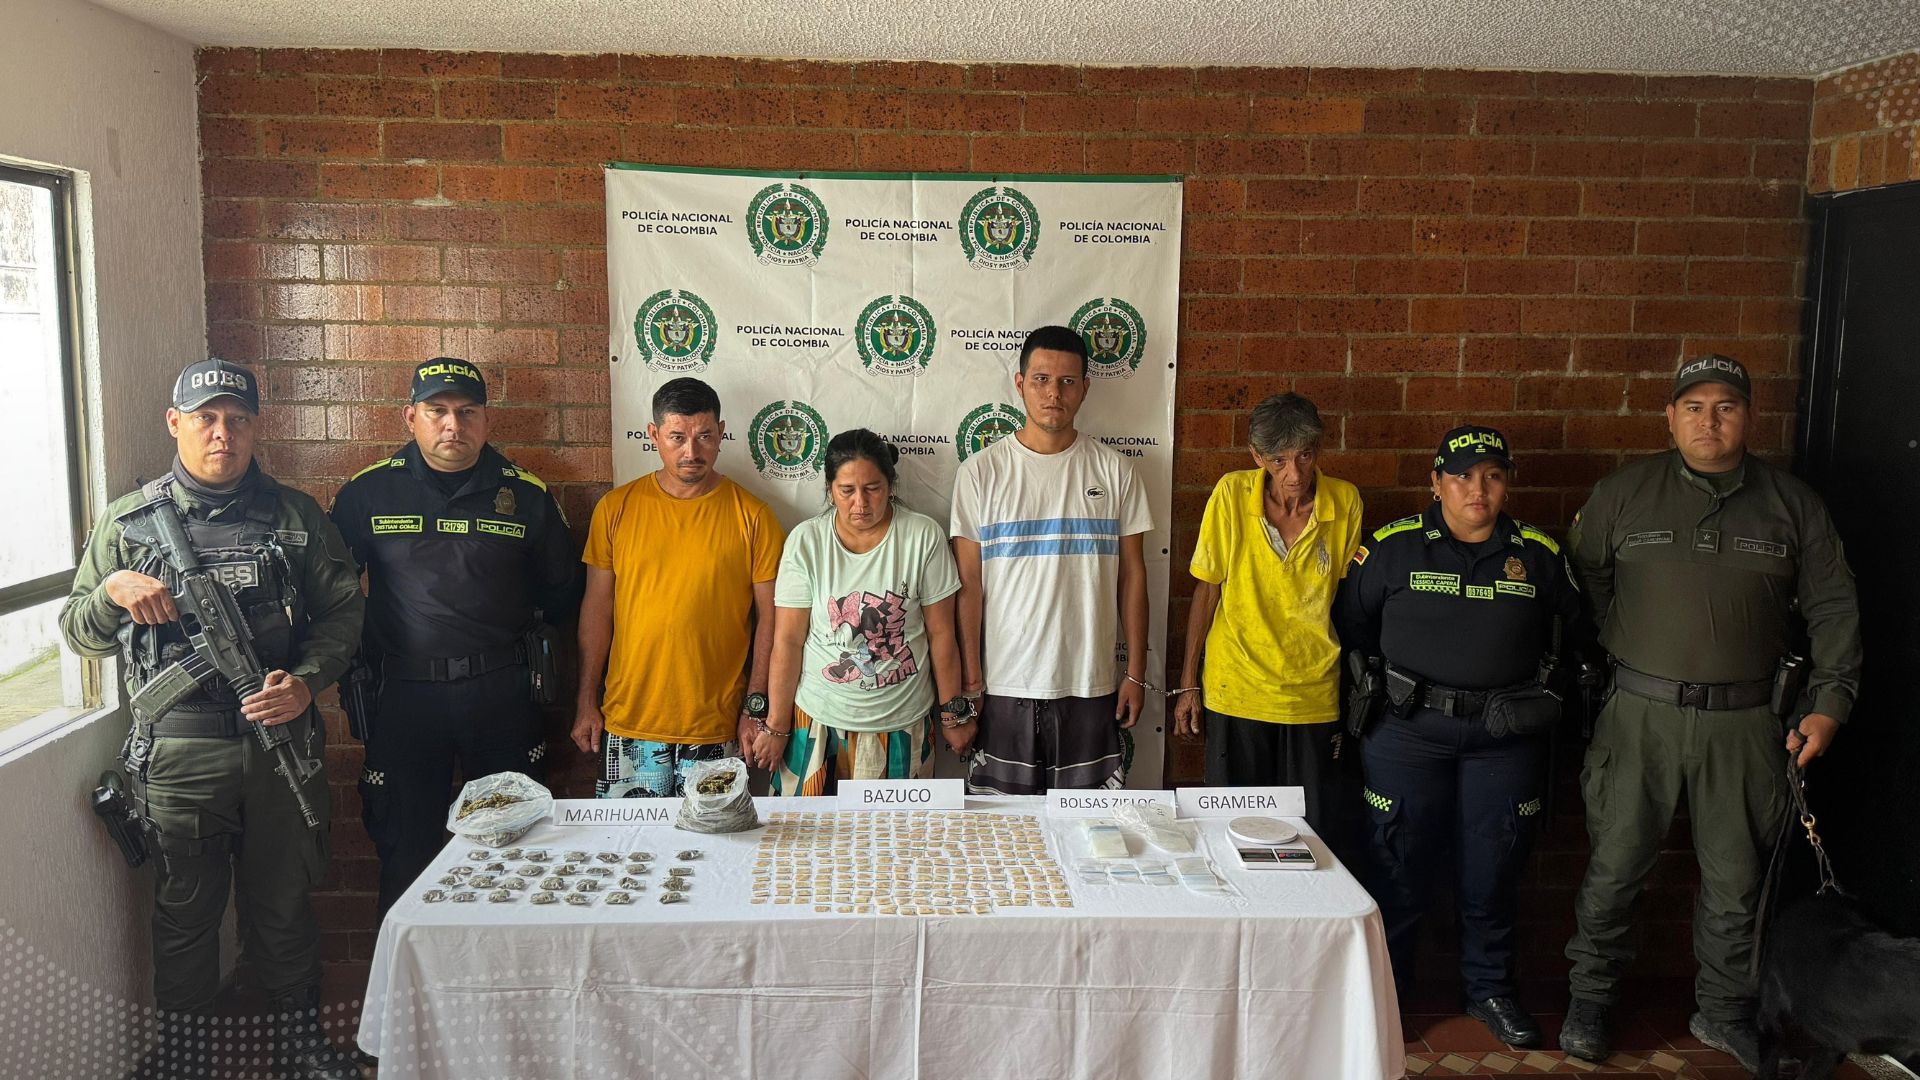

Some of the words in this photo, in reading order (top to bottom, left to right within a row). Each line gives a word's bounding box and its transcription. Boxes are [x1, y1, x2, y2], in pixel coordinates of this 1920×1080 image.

[621, 209, 669, 221] POLICÍA
[671, 212, 733, 224] NACIONAL
[799, 196, 819, 230] COLOMBIA
[1011, 200, 1031, 234] COLOMBIA
[637, 224, 654, 234] DE
[656, 225, 718, 236] COLOMBIA
[845, 217, 890, 228] POLICÍA
[893, 220, 953, 230] NACIONAL
[1060, 220, 1104, 230] POLICÍA
[1107, 222, 1166, 231] NACIONAL
[860, 231, 875, 240] DE
[878, 232, 938, 242] COLOMBIA
[1074, 234, 1088, 243] DE
[1091, 235, 1151, 243] COLOMBIA
[788, 238, 816, 256] NACIONAL
[999, 241, 1027, 260] NACIONAL
[687, 302, 708, 336] COLOMBIA
[907, 307, 927, 341] COLOMBIA
[1077, 309, 1098, 335] PUBLICA
[1118, 310, 1137, 343] COLOMBIA
[736, 324, 782, 334] POLICÍA
[785, 326, 845, 336] NACIONAL
[950, 328, 994, 338] POLICÍA
[998, 330, 1032, 339] NACIO
[752, 338, 766, 346] DE
[769, 338, 829, 348] COLOMBIA
[965, 342, 980, 350] DE
[983, 342, 1023, 351] COLOM
[677, 343, 705, 362] NACIONAL
[895, 348, 924, 367] NACIONAL
[1105, 350, 1135, 369] NACIONAL
[418, 363, 480, 382] POLICÍA
[1679, 359, 1744, 379] POLICÍA
[191, 370, 248, 391] GOES
[800, 413, 819, 446] COLOMBIA
[892, 434, 950, 444] NACIONAL
[1100, 436, 1159, 446] NACIONAL
[1448, 431, 1503, 453] POLICÍA
[642, 443, 658, 452] DE
[900, 446, 935, 455] OMBIA
[789, 452, 817, 471] NACIONAL
[442, 522, 466, 531] 121799
[480, 523, 522, 536] POLICÍA
[207, 565, 253, 585] OES
[863, 788, 932, 803] BAZUCO
[1060, 797, 1108, 809] BOLSAS
[1198, 795, 1277, 809] GRAMERA
[565, 807, 670, 823] MARIHUANA
